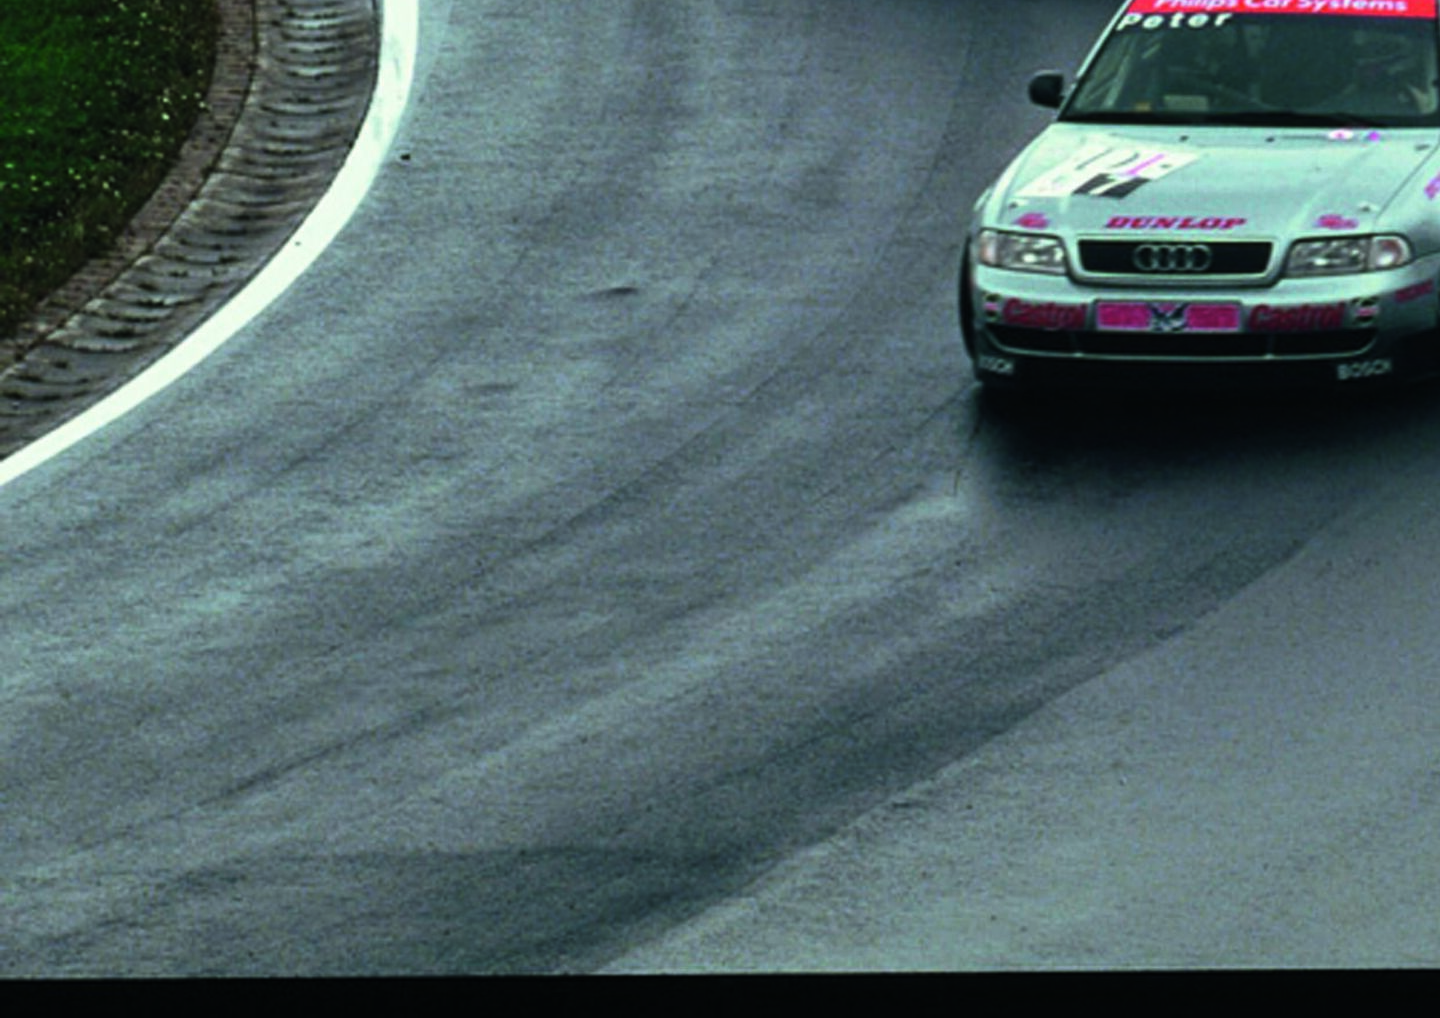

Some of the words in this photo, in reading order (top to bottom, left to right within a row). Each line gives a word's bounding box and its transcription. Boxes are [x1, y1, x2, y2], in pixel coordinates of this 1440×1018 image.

[1115, 12, 1233, 31] Peter
[1104, 215, 1248, 230] DUNLOP
[1002, 297, 1086, 329] Castrol
[1248, 301, 1346, 329] Castrol
[1336, 358, 1392, 379] BOSCH
